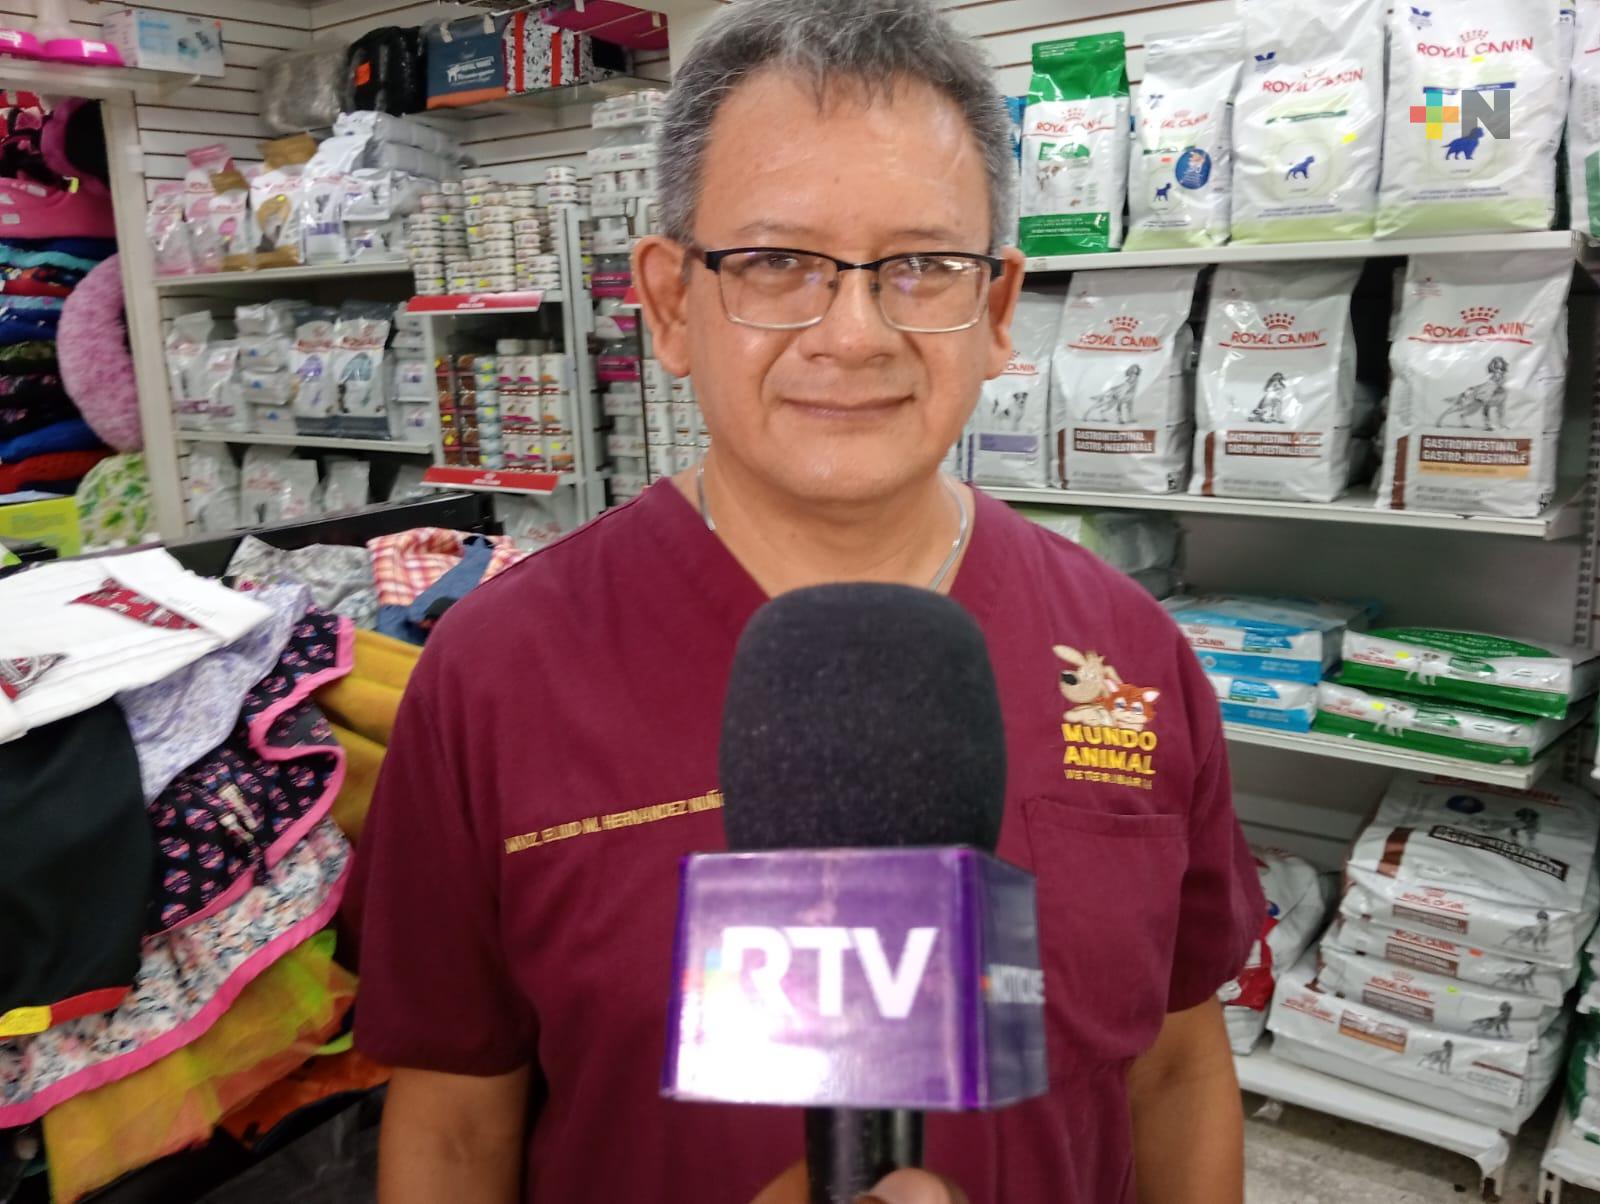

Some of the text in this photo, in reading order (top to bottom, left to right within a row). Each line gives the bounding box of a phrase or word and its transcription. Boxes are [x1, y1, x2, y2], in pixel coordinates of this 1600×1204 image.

[1417, 37, 1534, 58] ROYAL CANIN
[1231, 330, 1321, 345] ROYAL CANIN
[1423, 322, 1526, 338] ROYAL CANIN
[1120, 335, 1162, 347] CANIN
[1423, 437, 1519, 452] GASTROINTESTINAL
[1421, 449, 1528, 464] GASTRO-INTESTINALE
[1061, 723, 1158, 751] MUNDO
[1063, 746, 1156, 775] ANIMAL
[601, 799, 689, 830] HERNANDEZ
[718, 925, 939, 1020] RTV
